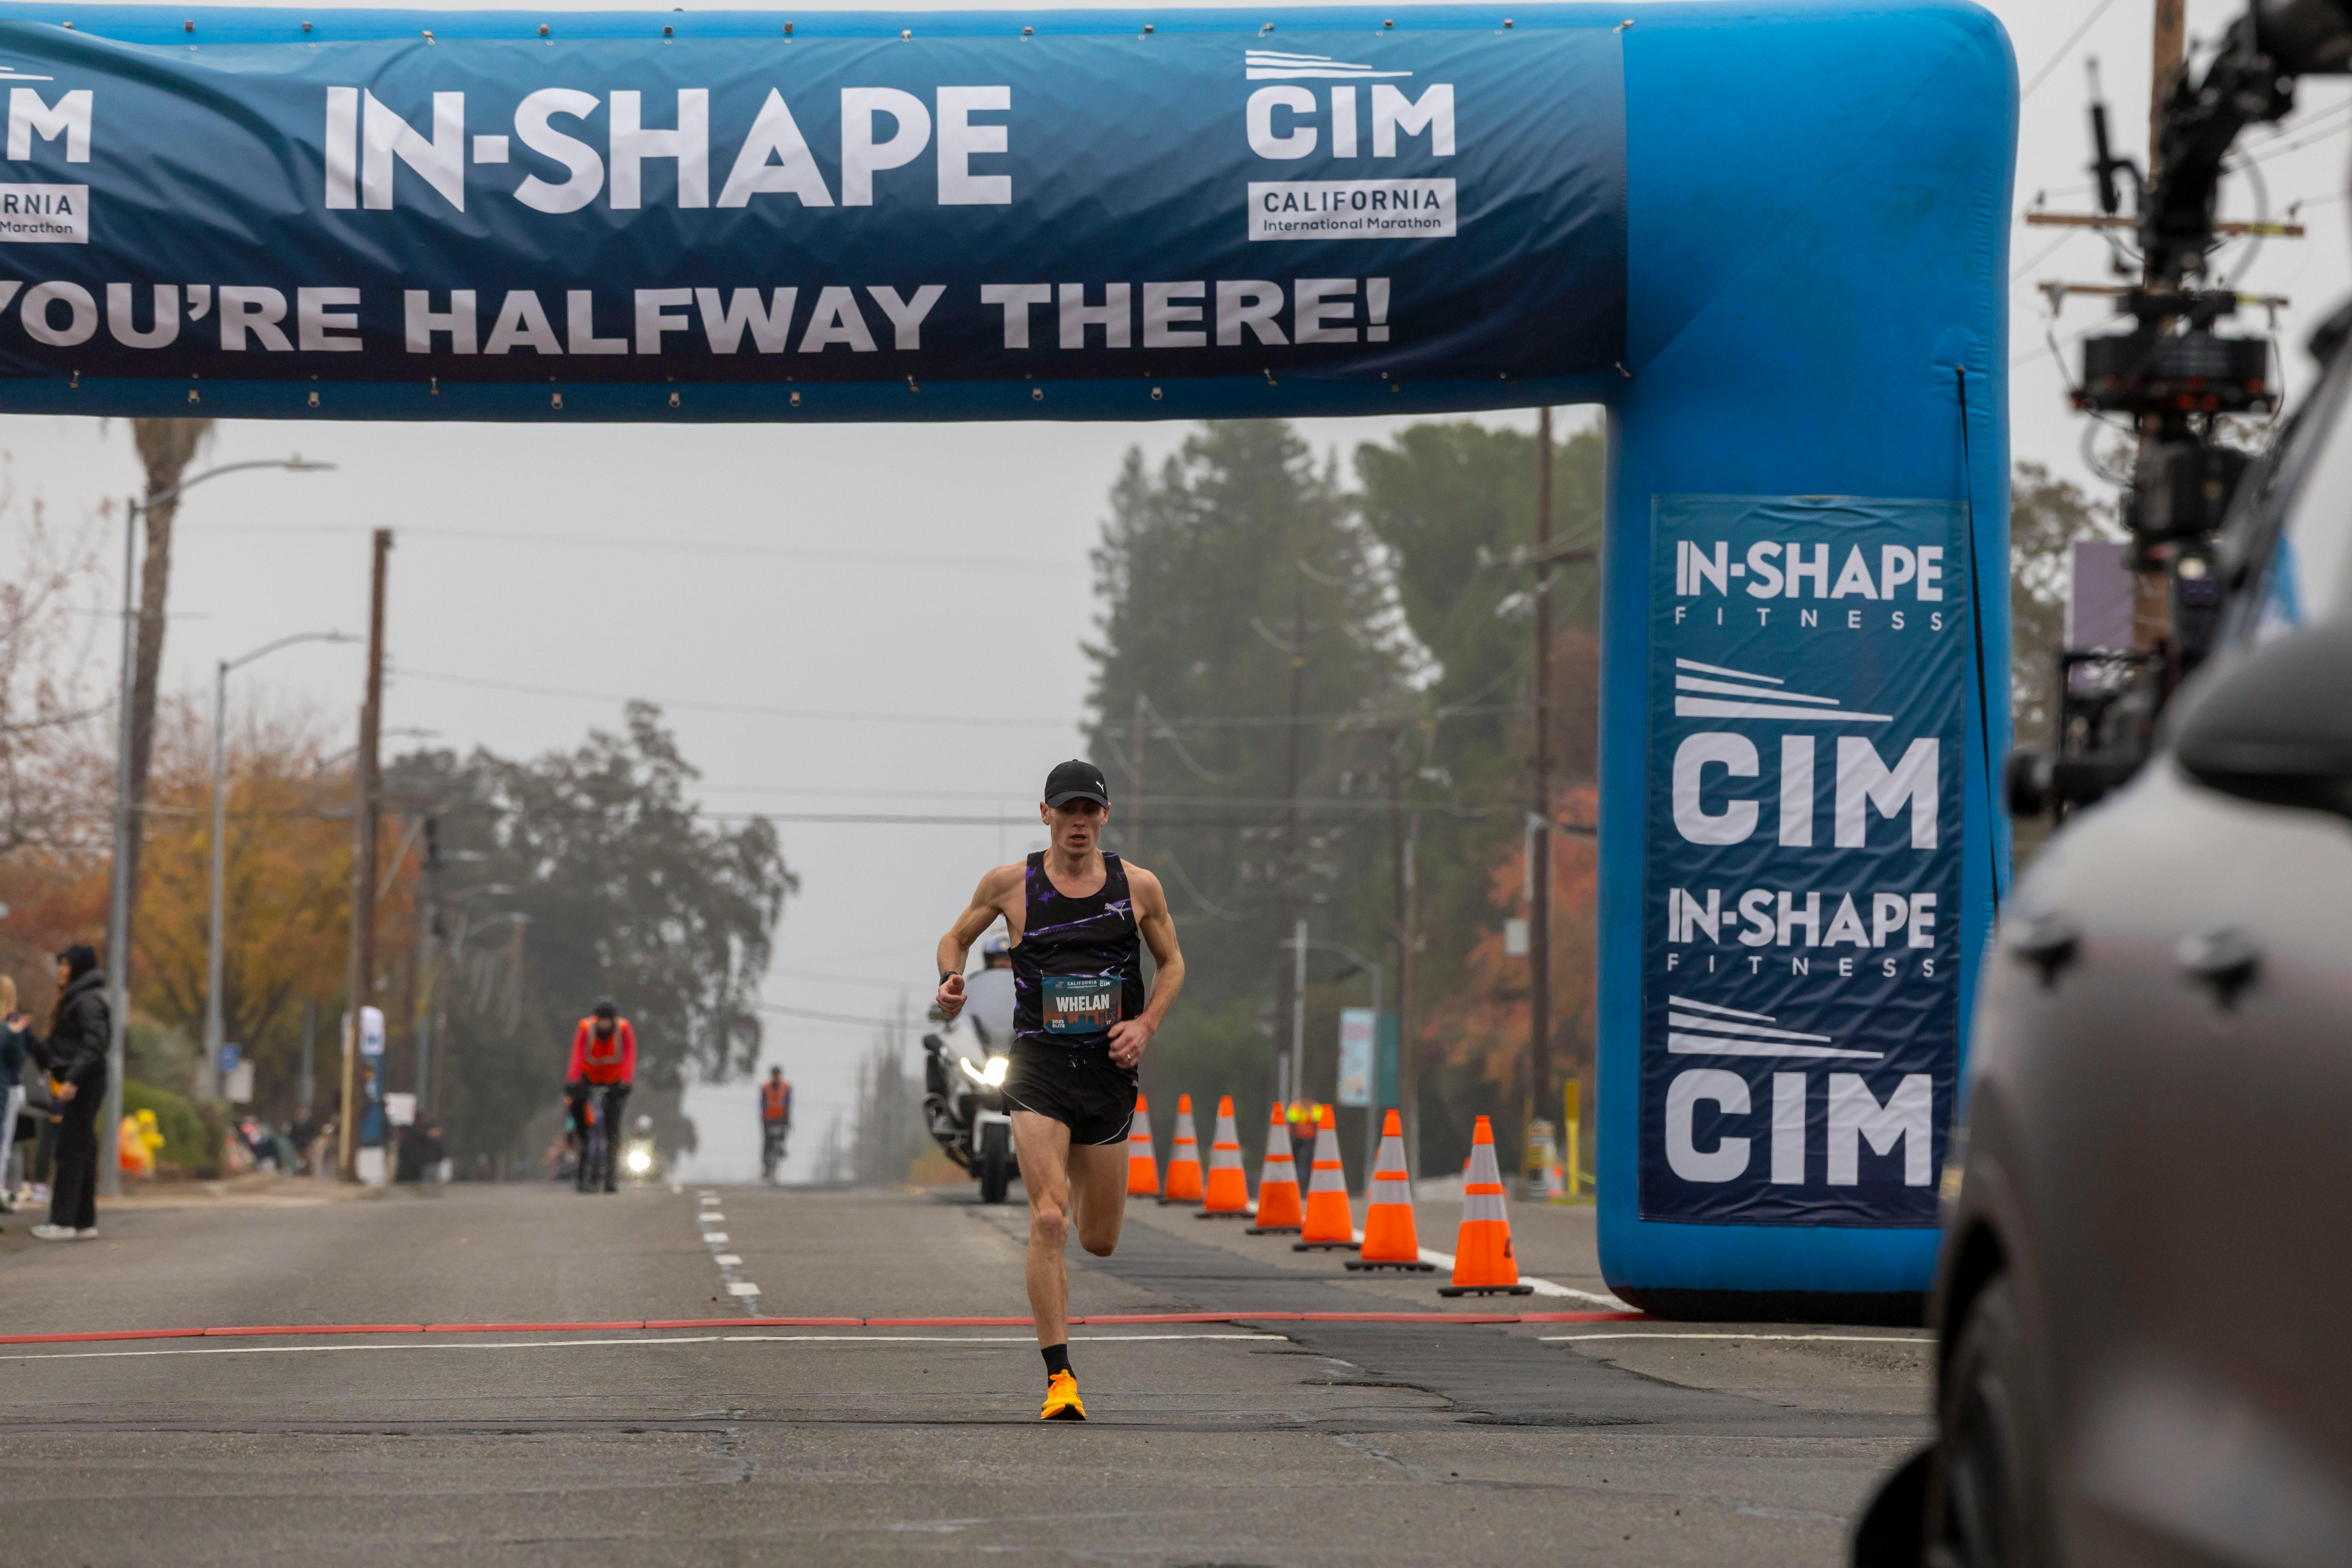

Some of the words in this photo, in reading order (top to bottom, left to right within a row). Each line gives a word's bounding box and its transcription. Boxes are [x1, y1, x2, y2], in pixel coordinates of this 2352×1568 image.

[325, 85, 1012, 214] IN-SHAPE
[1246, 83, 1456, 160] CIM
[0, 221, 73, 234] Marathon
[1264, 189, 1440, 212] CALIFORNIA
[1264, 218, 1362, 231] International
[1367, 217, 1441, 229] Marathon
[404, 285, 947, 354] HALFWAY
[980, 277, 1390, 349] THERE!
[1676, 541, 1943, 602] IN-SHAPE
[1675, 606, 1942, 631] FITNESS
[1672, 732, 1940, 849] CIM
[1668, 888, 1937, 949] IN-SHAPE
[1668, 953, 1935, 978] FITNESS
[1056, 994, 1110, 1012] WHELAN
[1665, 1068, 1932, 1187] CIM
